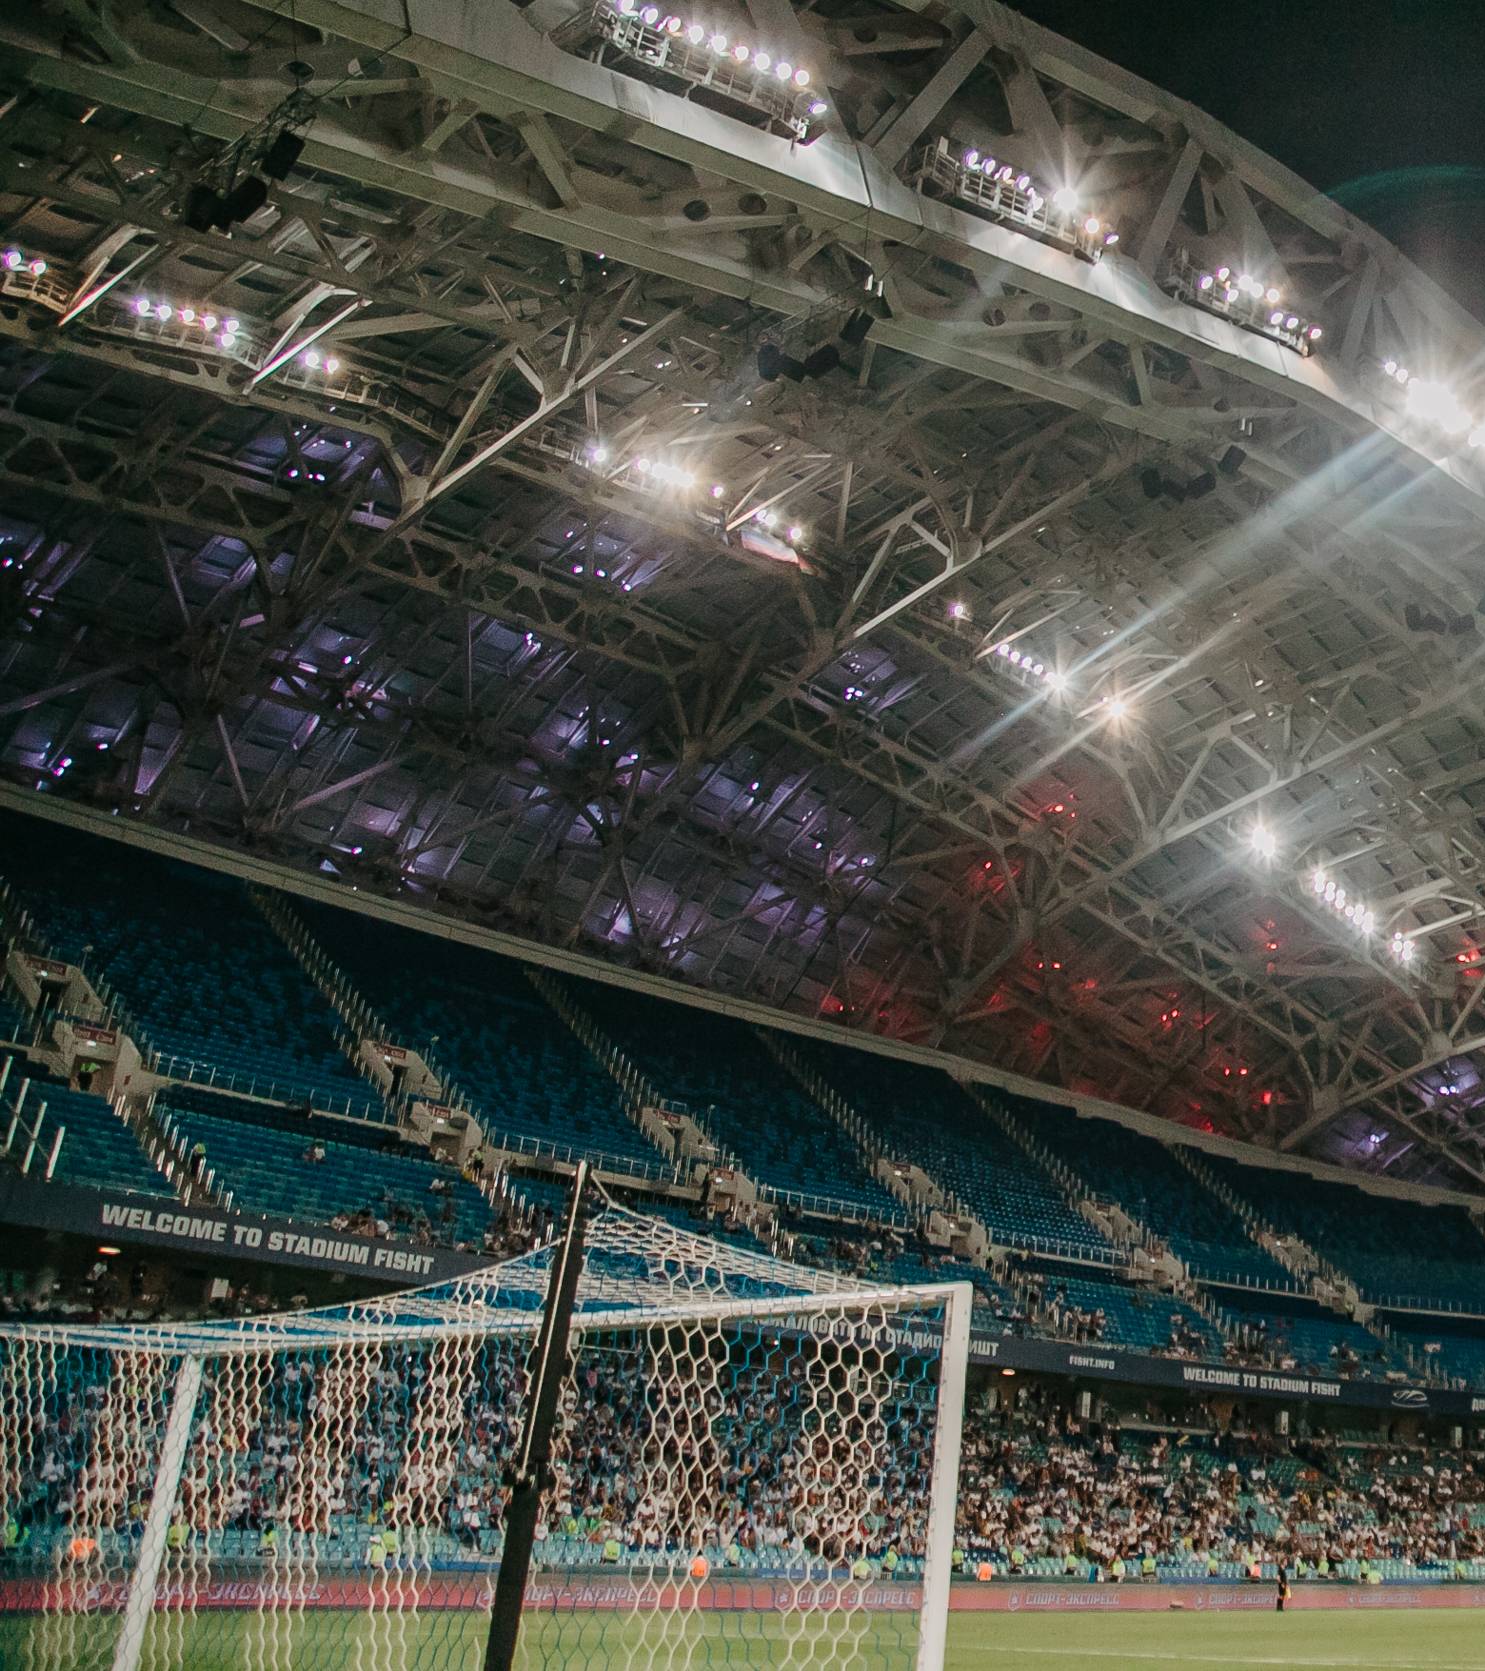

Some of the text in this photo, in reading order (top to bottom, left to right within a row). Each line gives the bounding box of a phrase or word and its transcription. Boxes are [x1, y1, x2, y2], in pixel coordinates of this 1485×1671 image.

[102, 1204, 435, 1275] WELCOME TO STADIUM FISHT
[885, 1327, 943, 1351] СТАДИО
[968, 1337, 999, 1358] ИШТ
[1069, 1355, 1115, 1370] FISHT.INFO
[1183, 1366, 1341, 1397] WELCOME TO STADIUM FISHT
